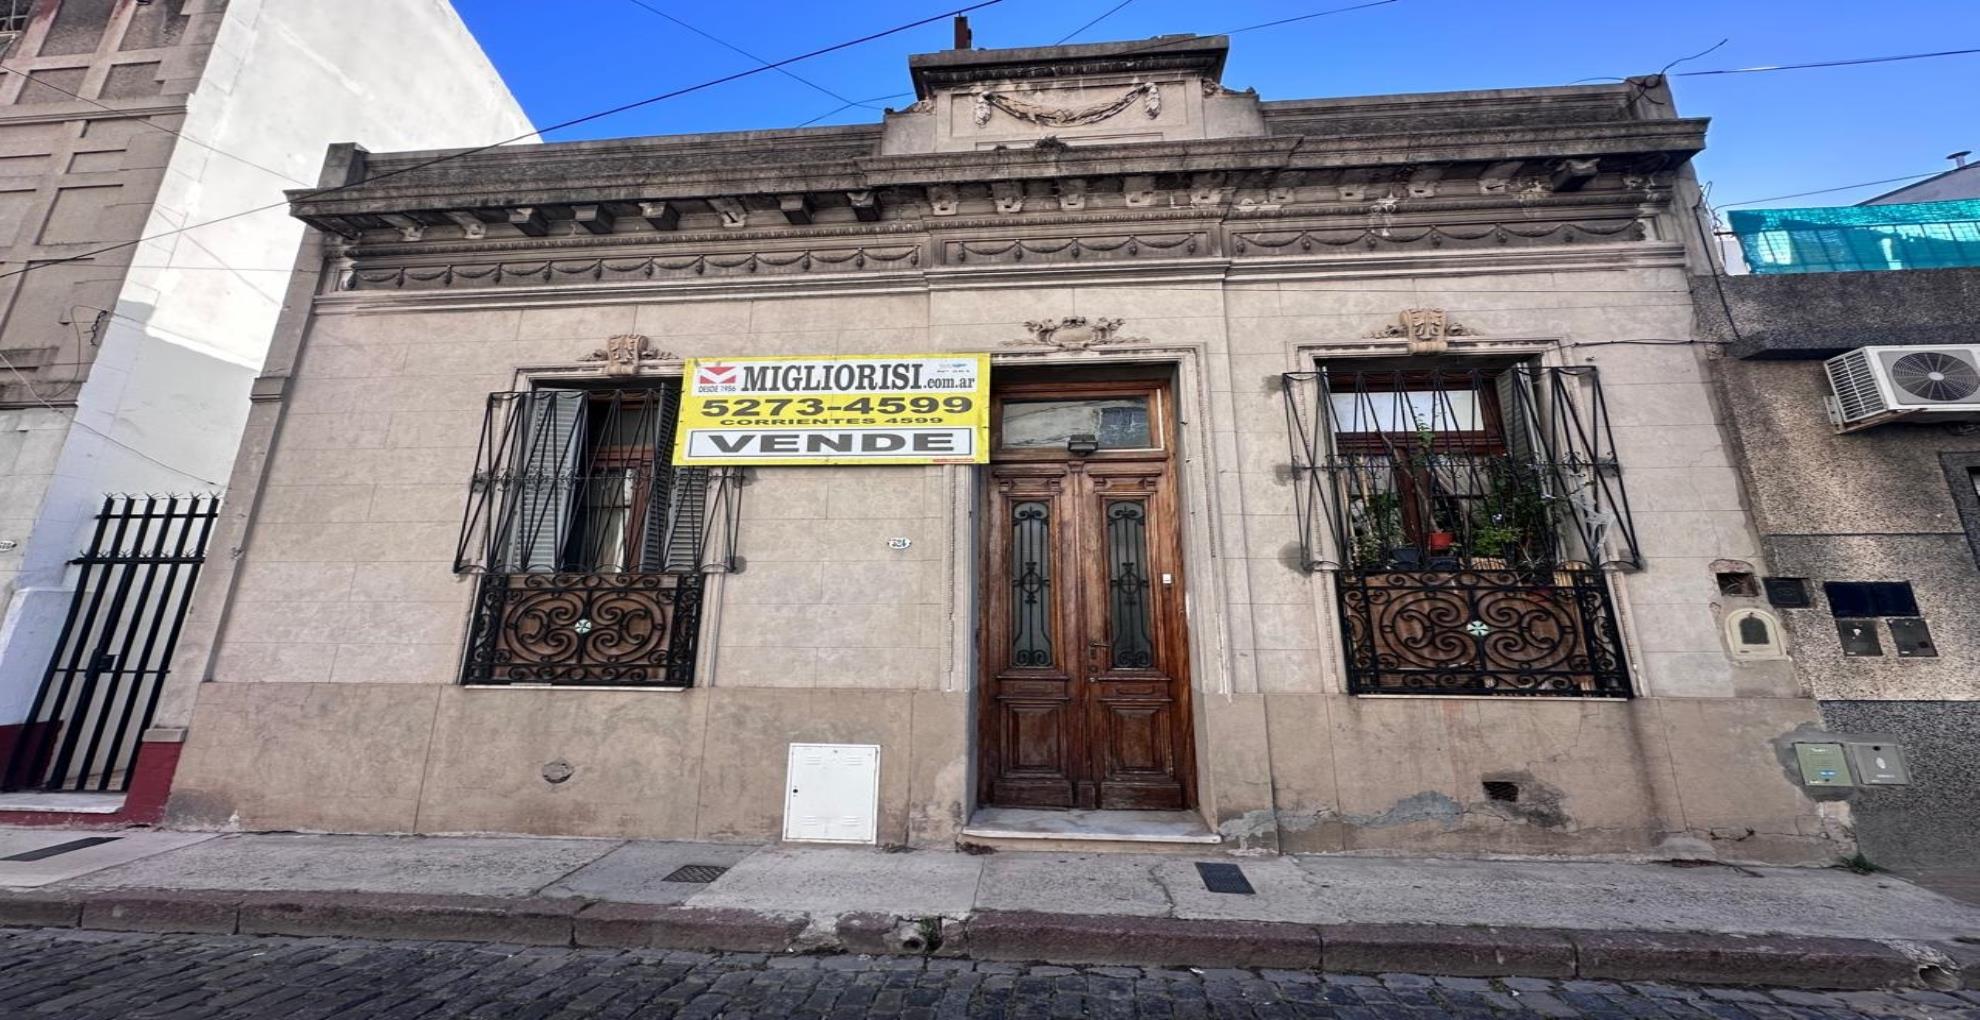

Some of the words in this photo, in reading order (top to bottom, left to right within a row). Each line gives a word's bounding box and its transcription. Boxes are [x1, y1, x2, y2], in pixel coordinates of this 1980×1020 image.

[702, 396, 972, 417] 5273-4599
[720, 418, 875, 426] CORRIENTES
[708, 432, 955, 453] VENDE
